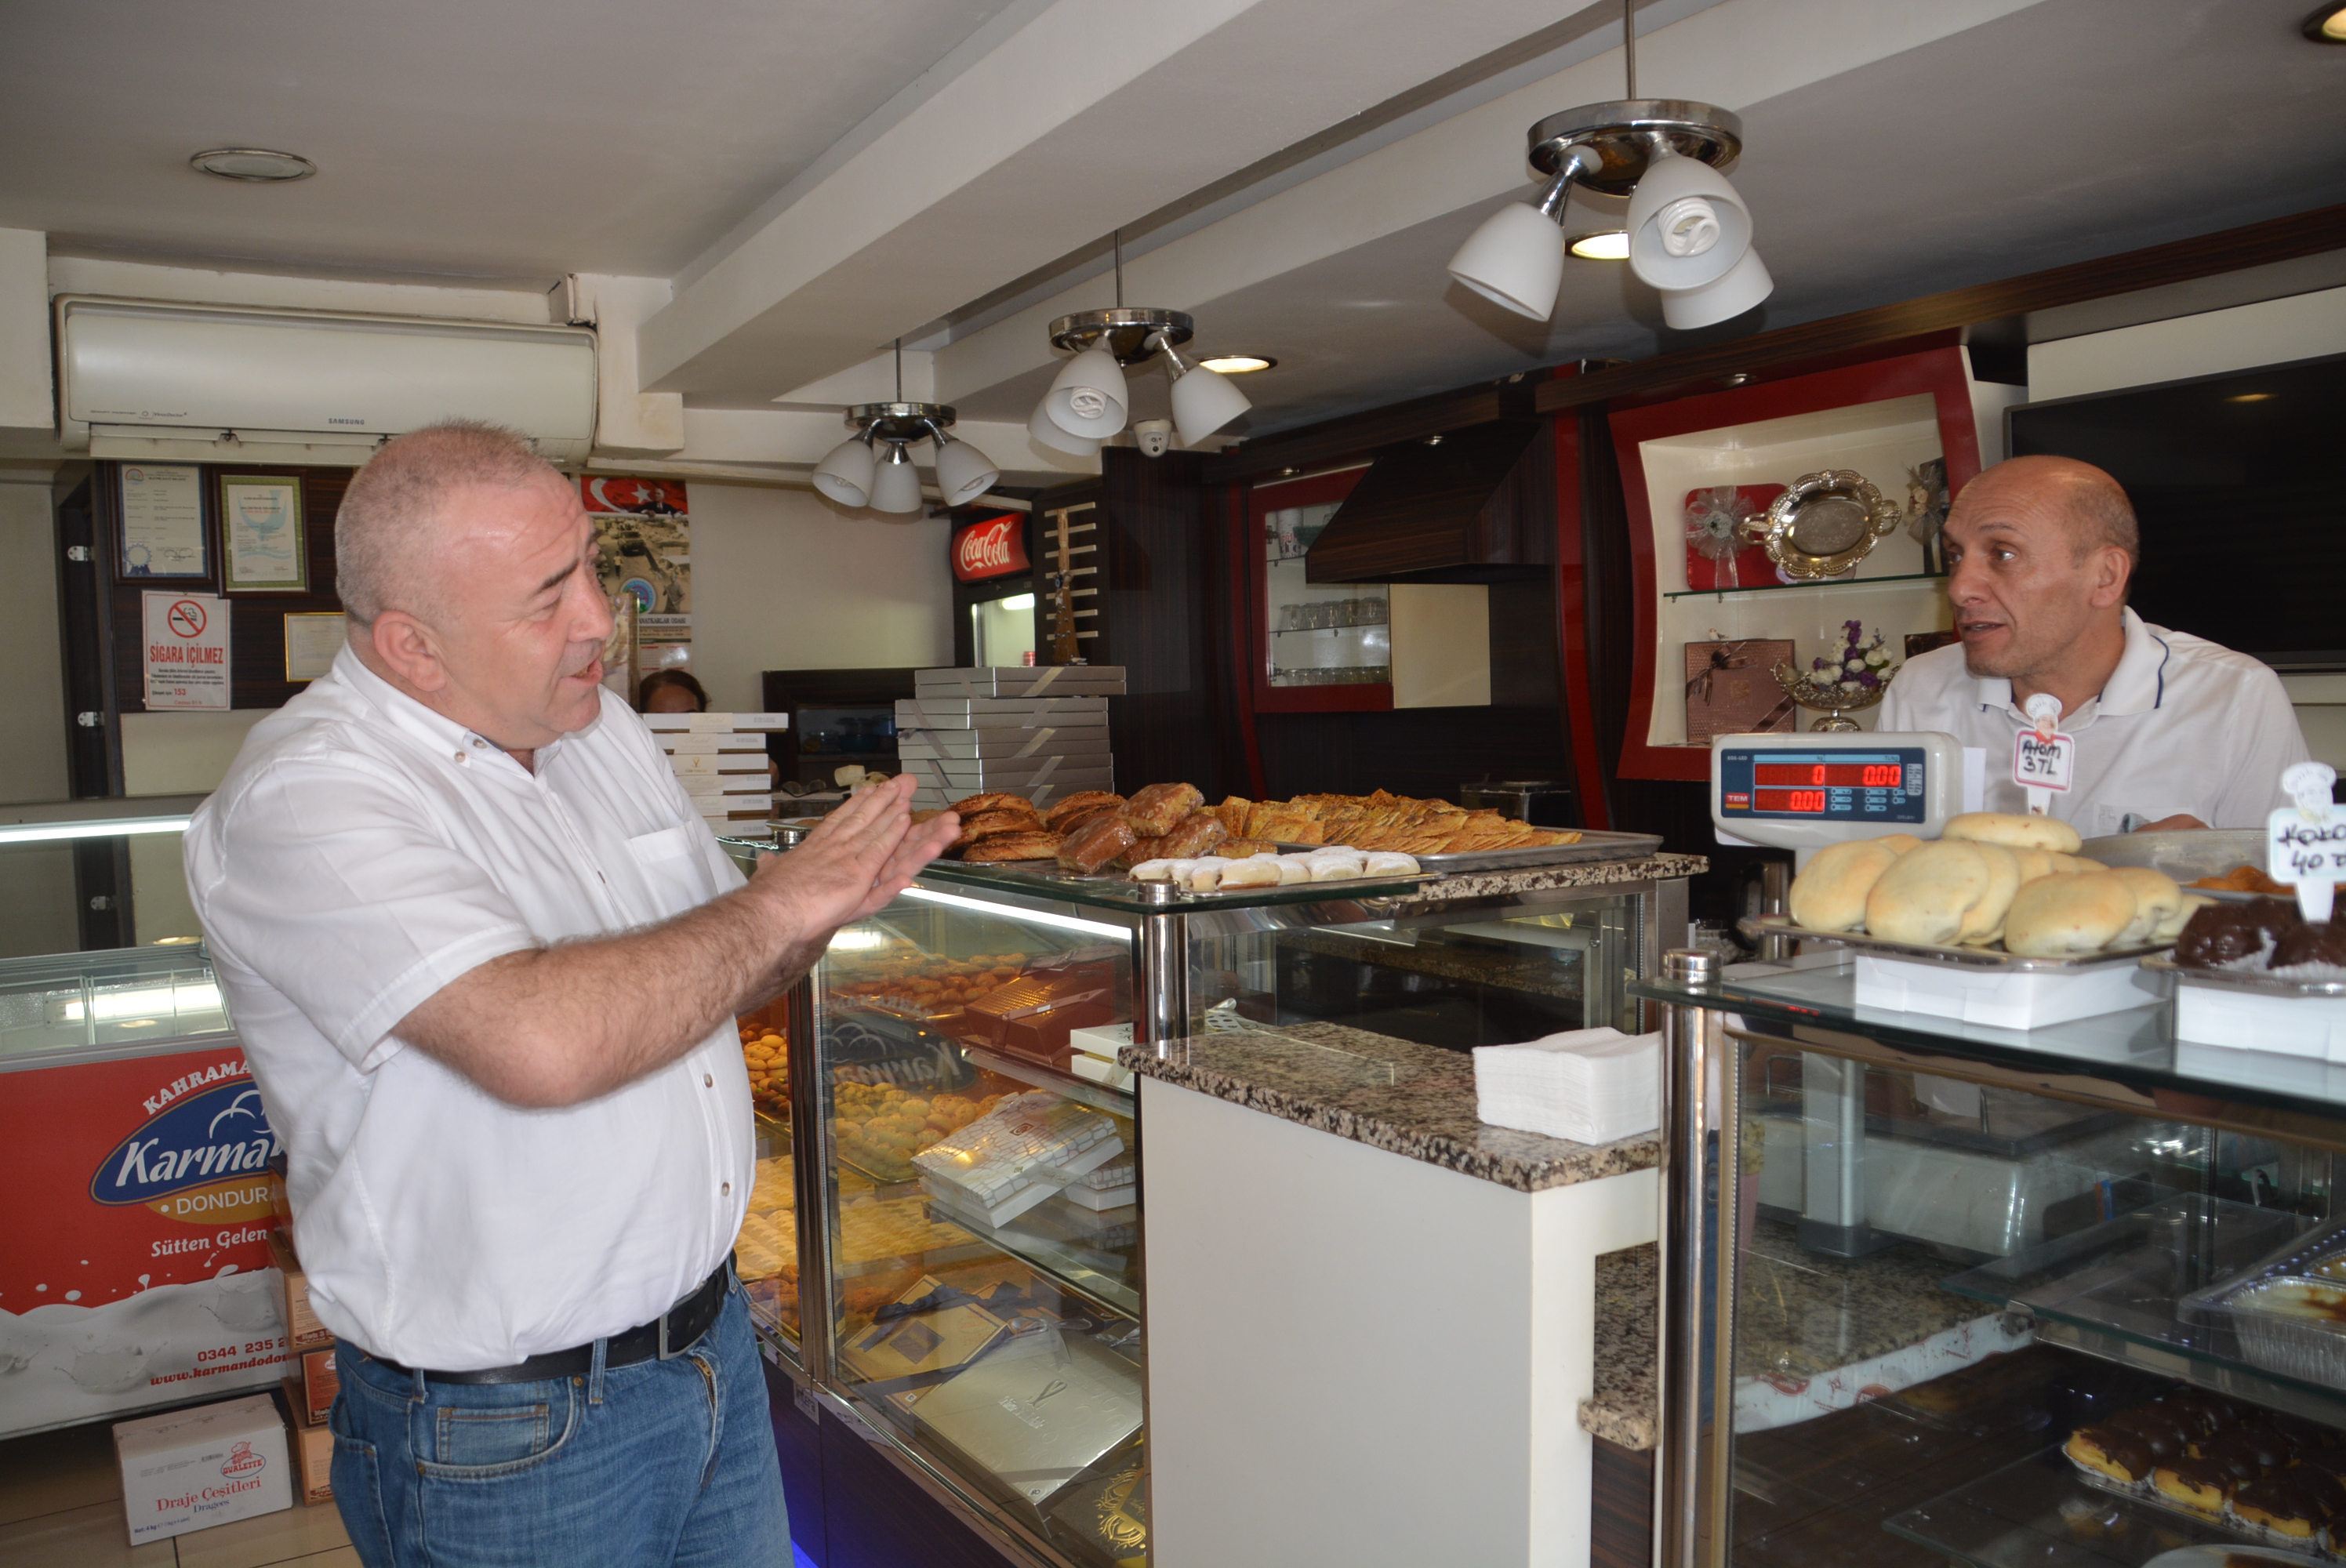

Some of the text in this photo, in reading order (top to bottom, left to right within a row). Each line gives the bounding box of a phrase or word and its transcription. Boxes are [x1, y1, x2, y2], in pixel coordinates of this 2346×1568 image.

[150, 641, 223, 668] SİGARA İÇİLMEZ
[1812, 764, 1825, 786] 0
[1863, 765, 1901, 786] 0.00
[1790, 790, 1825, 811] 0.00
[2291, 850, 2324, 876] 40
[151, 1227, 268, 1258] Sütten Gelen
[198, 1346, 237, 1362] 0344
[245, 1339, 274, 1353] 235
[223, 1458, 263, 1475] OVALETTE
[155, 1476, 262, 1512] Draje Çeşitleri
[193, 1499, 230, 1513] Dragees
